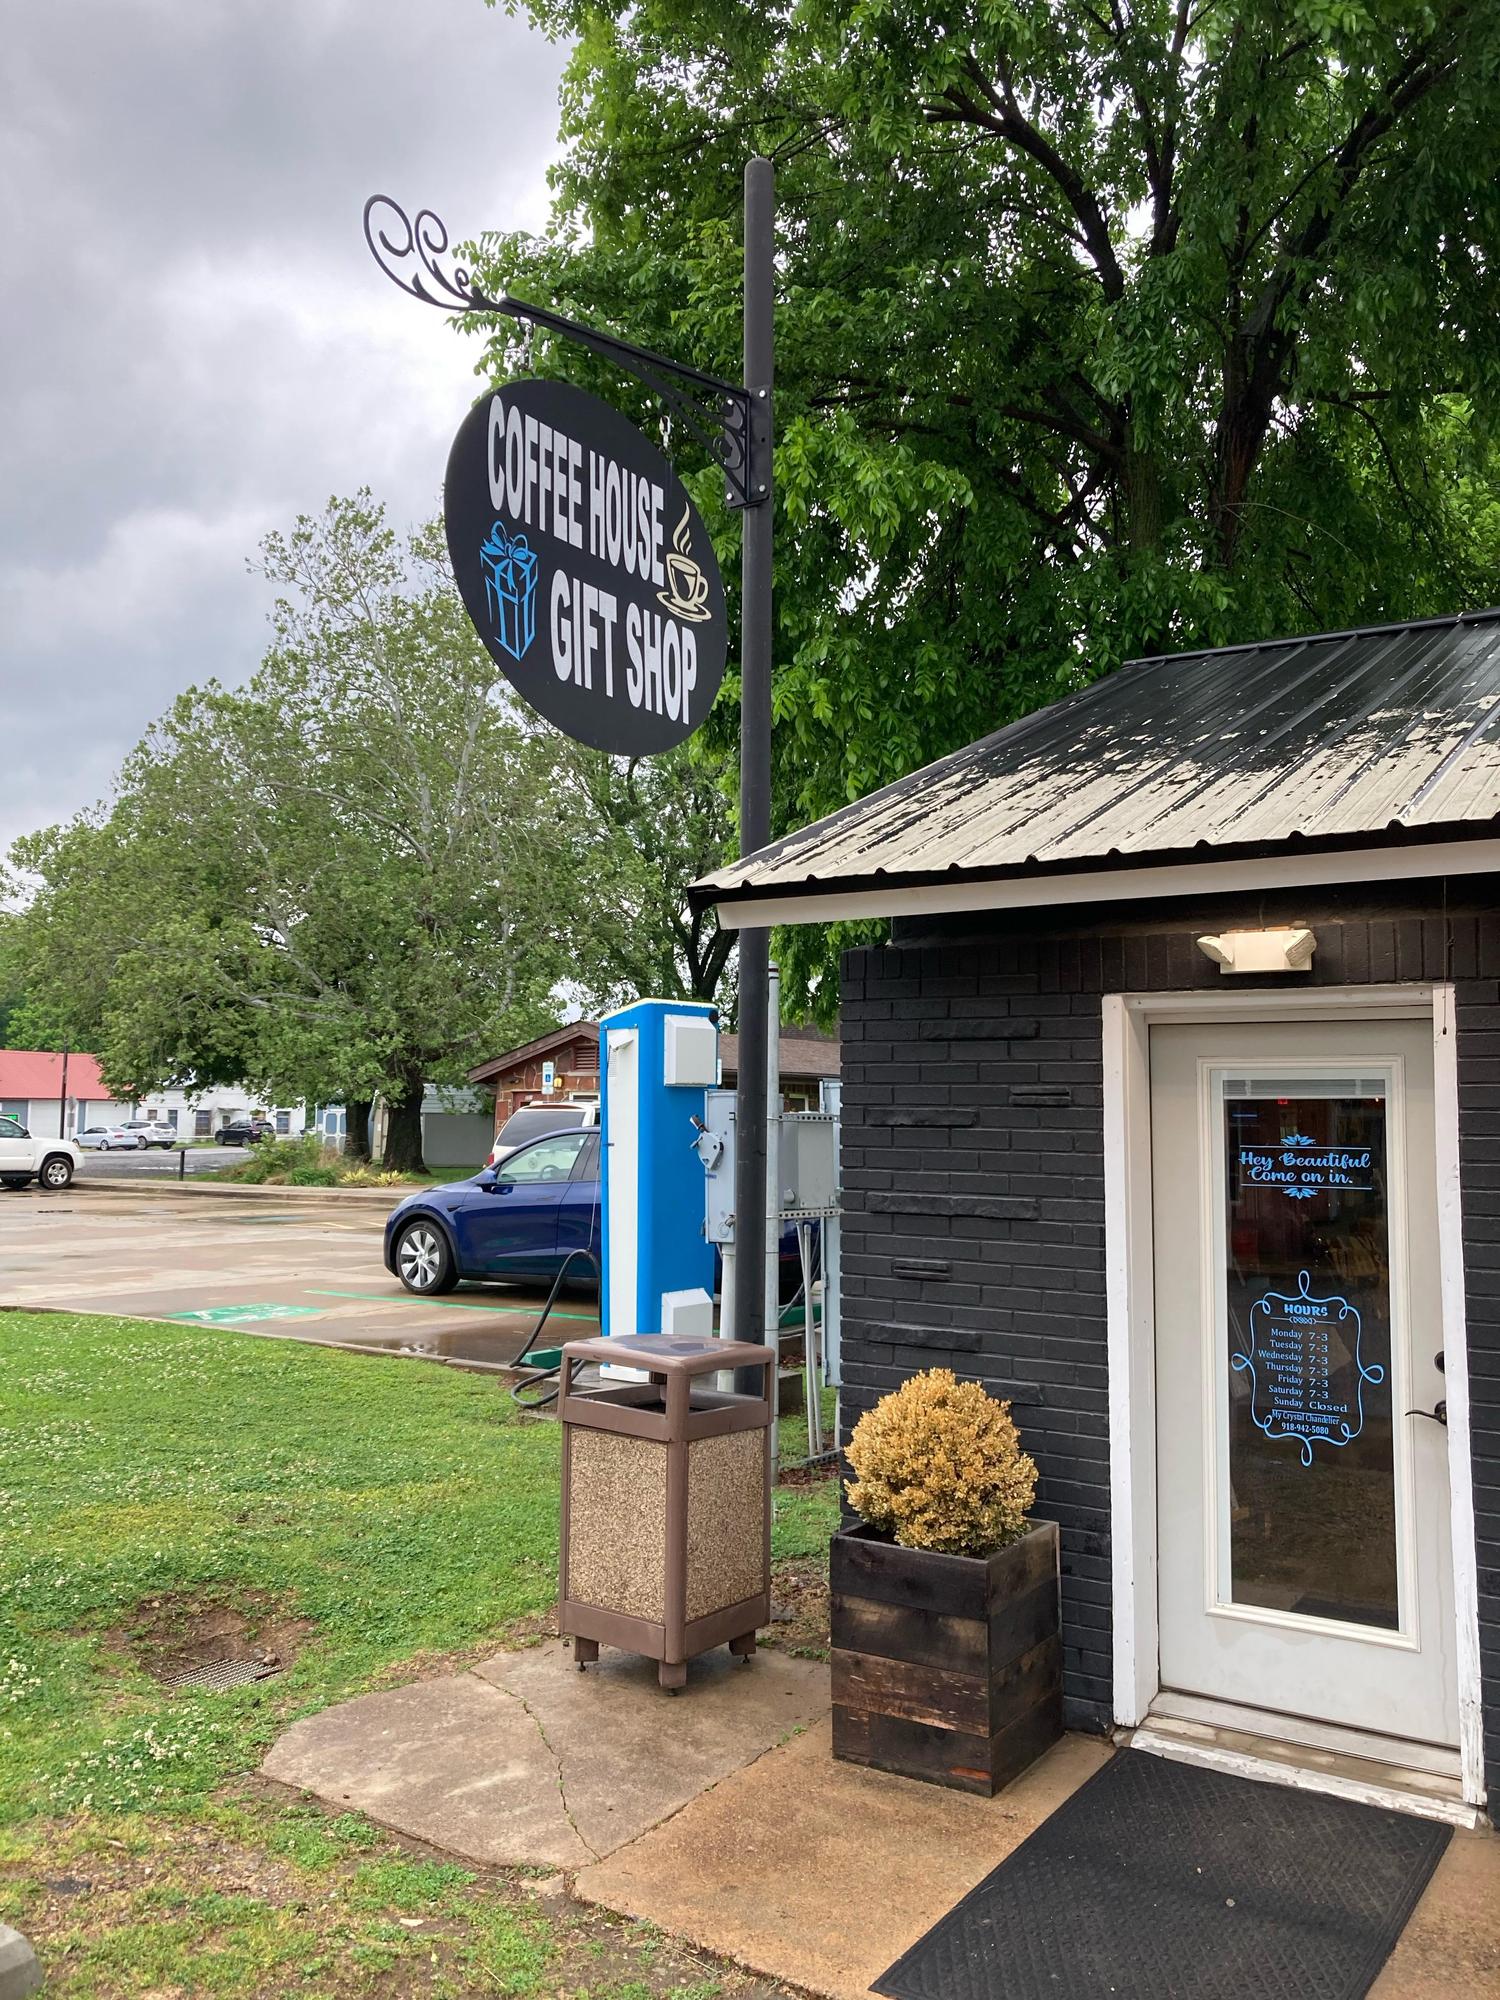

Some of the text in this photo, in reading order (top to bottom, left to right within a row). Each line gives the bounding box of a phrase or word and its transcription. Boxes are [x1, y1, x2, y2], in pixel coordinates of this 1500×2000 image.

[487, 394, 666, 587] COFFEE HOUSE
[550, 568, 697, 725] GIFT SHOP
[1238, 1151, 1371, 1171] Hey Beautiful
[1248, 1166, 1353, 1184] Come on in.
[1284, 1304, 1329, 1316] HOURS
[1271, 1328, 1328, 1342] Monday 7-3
[1269, 1339, 1328, 1353] Tuesday 7-3
[1258, 1350, 1328, 1365] Wednesday 7-3
[1265, 1362, 1329, 1377] Thursday 7-3
[1278, 1374, 1329, 1388] Friday 7-3
[1268, 1385, 1329, 1399] Saturday 7-3
[1274, 1397, 1348, 1413] Sunday Closed
[1271, 1409, 1340, 1425] My Crystal Chandelier
[1281, 1422, 1329, 1435] 918-942-5080
